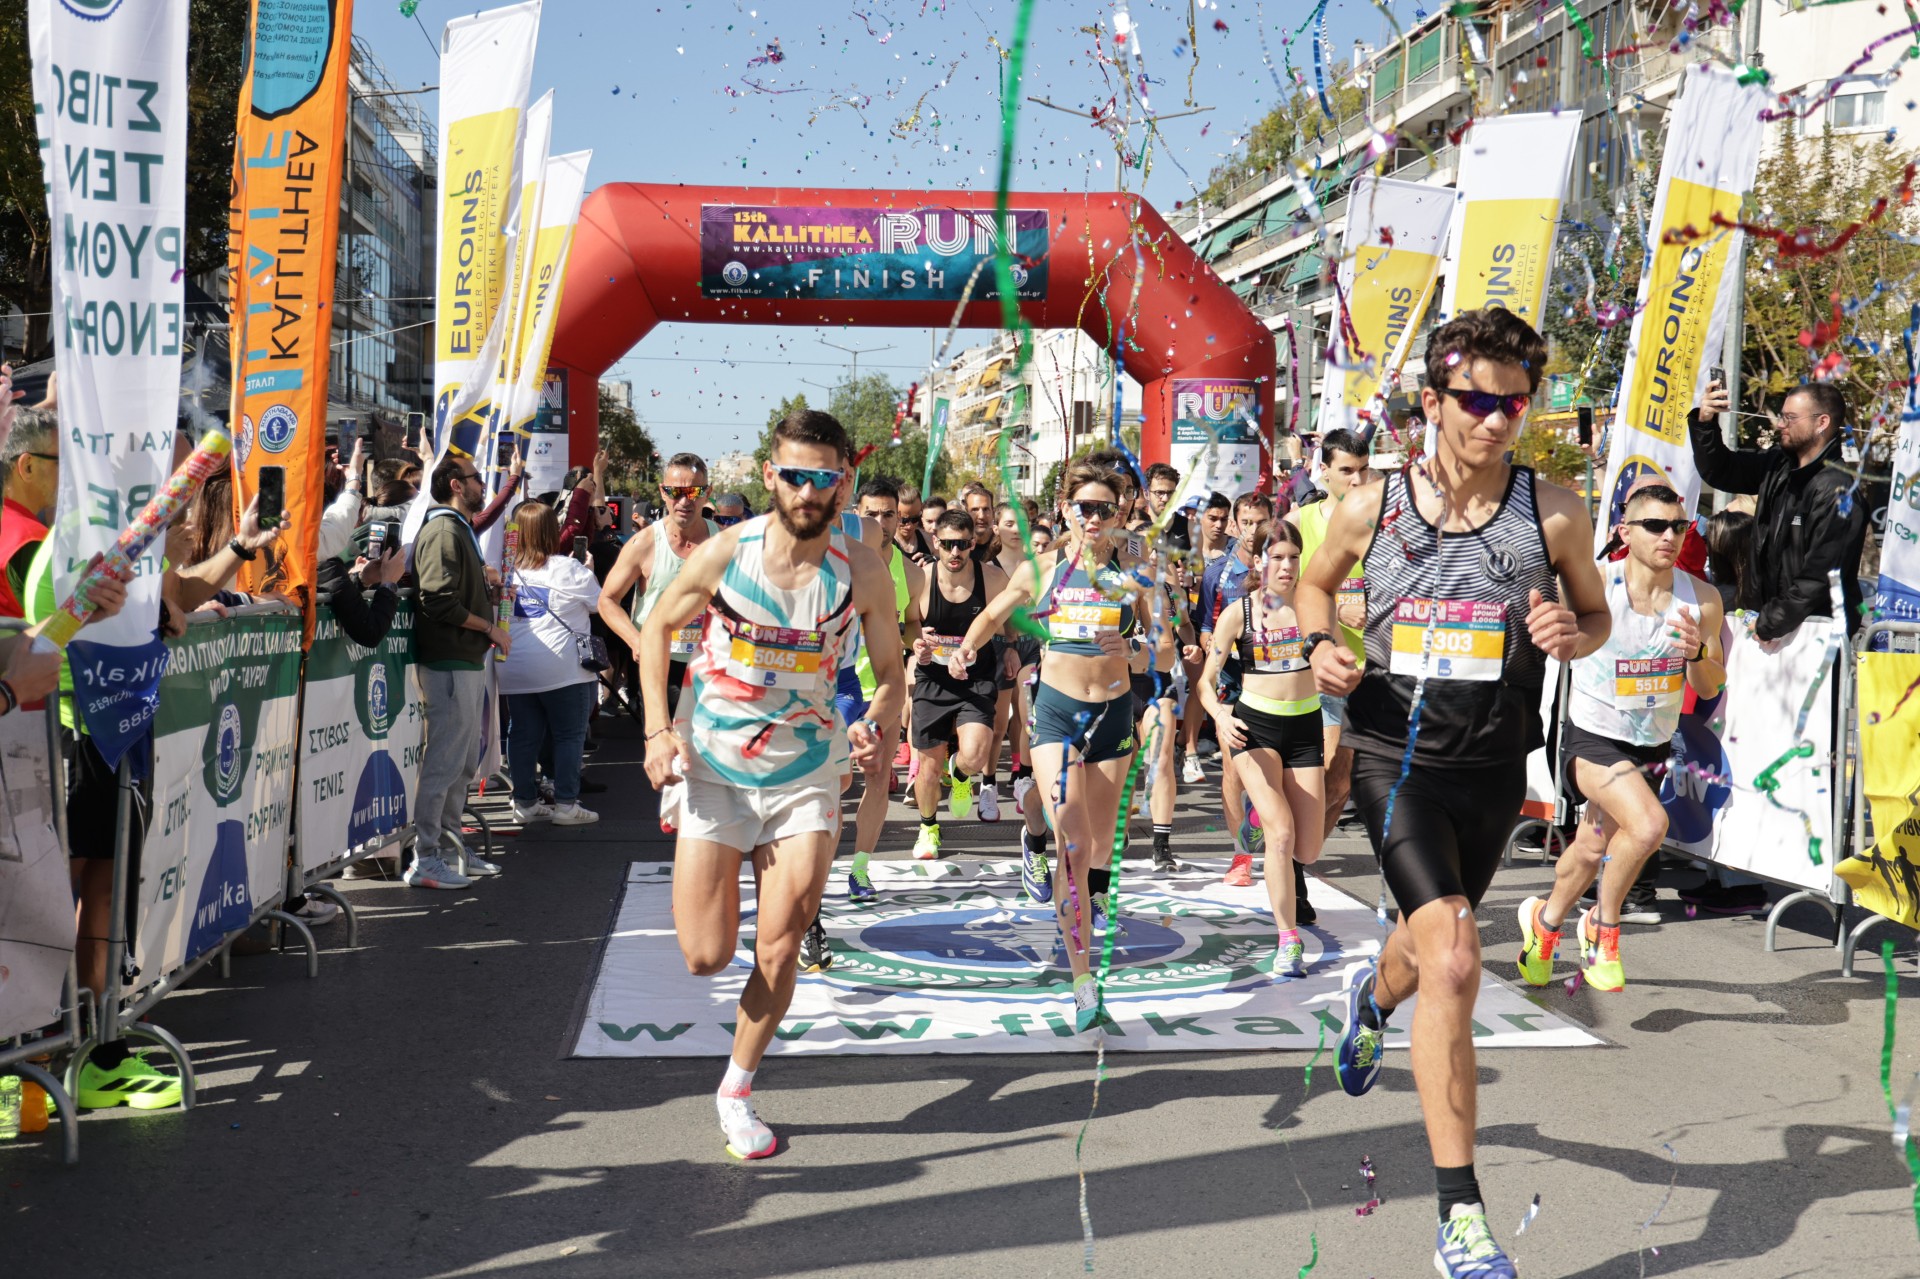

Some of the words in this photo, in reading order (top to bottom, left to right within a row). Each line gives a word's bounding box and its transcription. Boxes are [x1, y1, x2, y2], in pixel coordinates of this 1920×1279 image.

[477, 167, 489, 252] EUROHOLD
[488, 165, 499, 238] ΕΤΑΙΡΕΙΑ
[733, 211, 767, 223] 13th
[733, 224, 874, 244] KALLITHEA
[879, 213, 1017, 257] RUN
[733, 245, 874, 255] www.kallithearun.gr
[450, 169, 484, 354] EUROINS
[475, 262, 483, 279] OF
[808, 268, 945, 289] FINISH
[1511, 244, 1527, 313] EUROHOLD
[1524, 243, 1539, 302] ΕΤΑΙΡΕΙΑ
[709, 287, 763, 295] www.filkal.gr
[475, 289, 485, 353] MEMBER
[1645, 245, 1704, 433] EUROINS
[1204, 384, 1256, 394] KALLITHEA
[1664, 372, 1679, 436] MEMBER
[1676, 346, 1683, 364] OF
[1675, 335, 1697, 440] ΑΣΦΑΛΙΣΤΙΚΗ
[1177, 391, 1257, 421] RUN
[1337, 593, 1365, 605] 5289
[1472, 603, 1501, 611] ΑΓΩΝΑΣ
[1067, 607, 1102, 621] 5222
[1398, 601, 1447, 621] RUN
[1471, 610, 1500, 618] ΔΡΟΜΟΥ
[753, 648, 798, 669] 5045
[1271, 643, 1300, 658] 5255
[1618, 661, 1651, 673] RUN
[1635, 678, 1669, 692] 5514
[308, 722, 350, 754] ΣΤΙΒΟΣ
[313, 771, 345, 803] ΤΕΝΙΣ
[597, 1009, 1546, 1042] www.filkal.r
